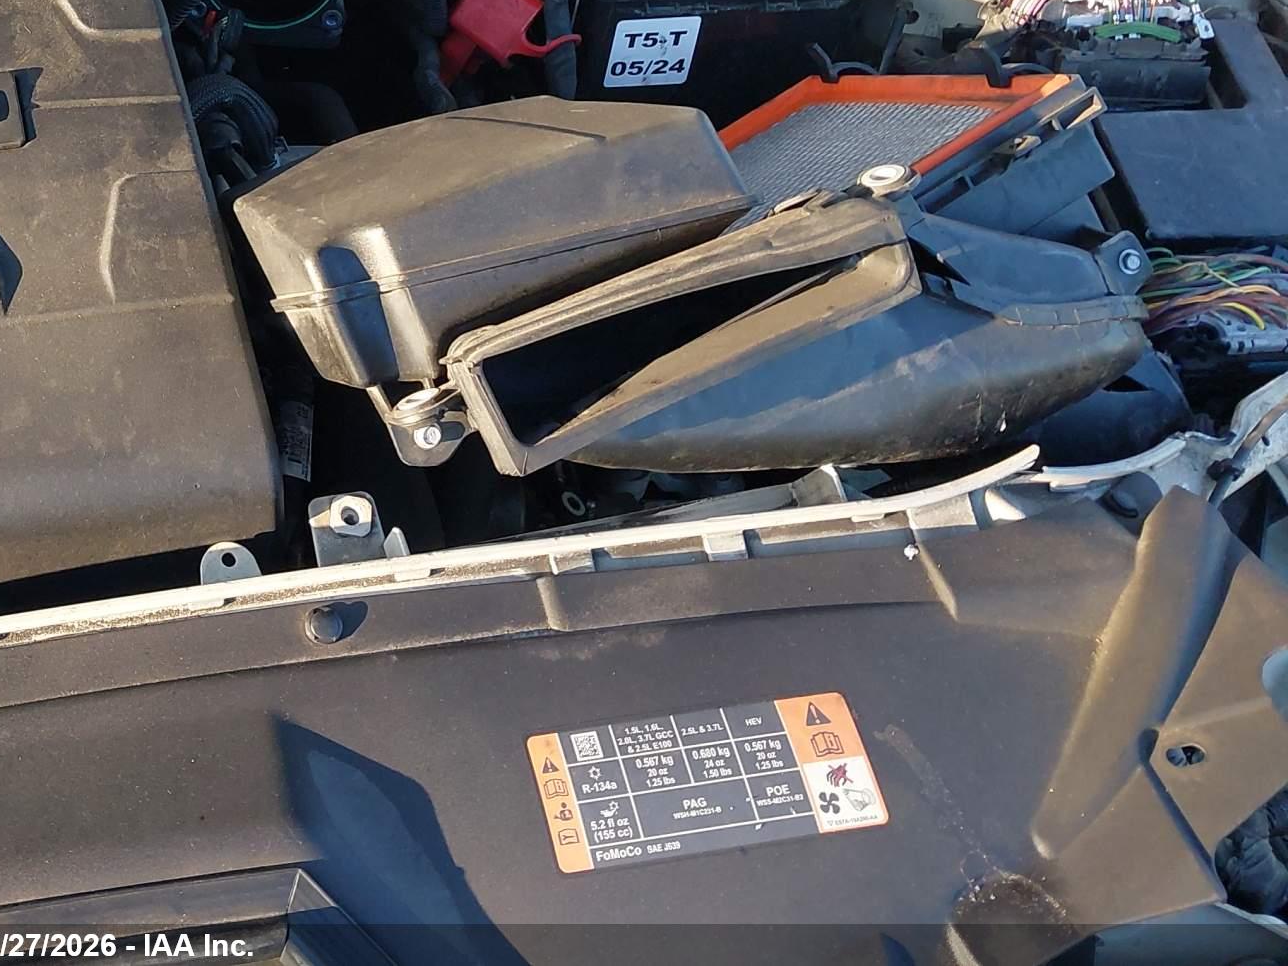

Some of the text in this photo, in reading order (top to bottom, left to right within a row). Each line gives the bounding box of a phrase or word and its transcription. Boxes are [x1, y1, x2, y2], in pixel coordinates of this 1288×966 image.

[610, 58, 686, 76] 05/24
[745, 717, 762, 726] HEV
[681, 723, 724, 736] 2.5L & 3.7L
[637, 733, 655, 742] 3.7L
[655, 730, 674, 739] GCC
[652, 740, 672, 750] E100
[744, 740, 782, 752] 0.567 kg
[717, 747, 731, 757] kg
[756, 752, 766, 760] 20
[660, 755, 674, 766] kg
[704, 759, 725, 769] 24 oz
[755, 759, 784, 771] 1.25 lbs
[647, 769, 658, 777] 20
[703, 767, 732, 779] 1.50 lbs
[582, 780, 618, 794] R-134a
[646, 776, 676, 788] 1.25 lbs
[766, 784, 791, 797] POE
[682, 797, 707, 810] PAG
[591, 817, 629, 831] 5.2 fl oz
[594, 826, 633, 844] (155 cc)
[595, 840, 681, 862] FoMoCo SAE J639
